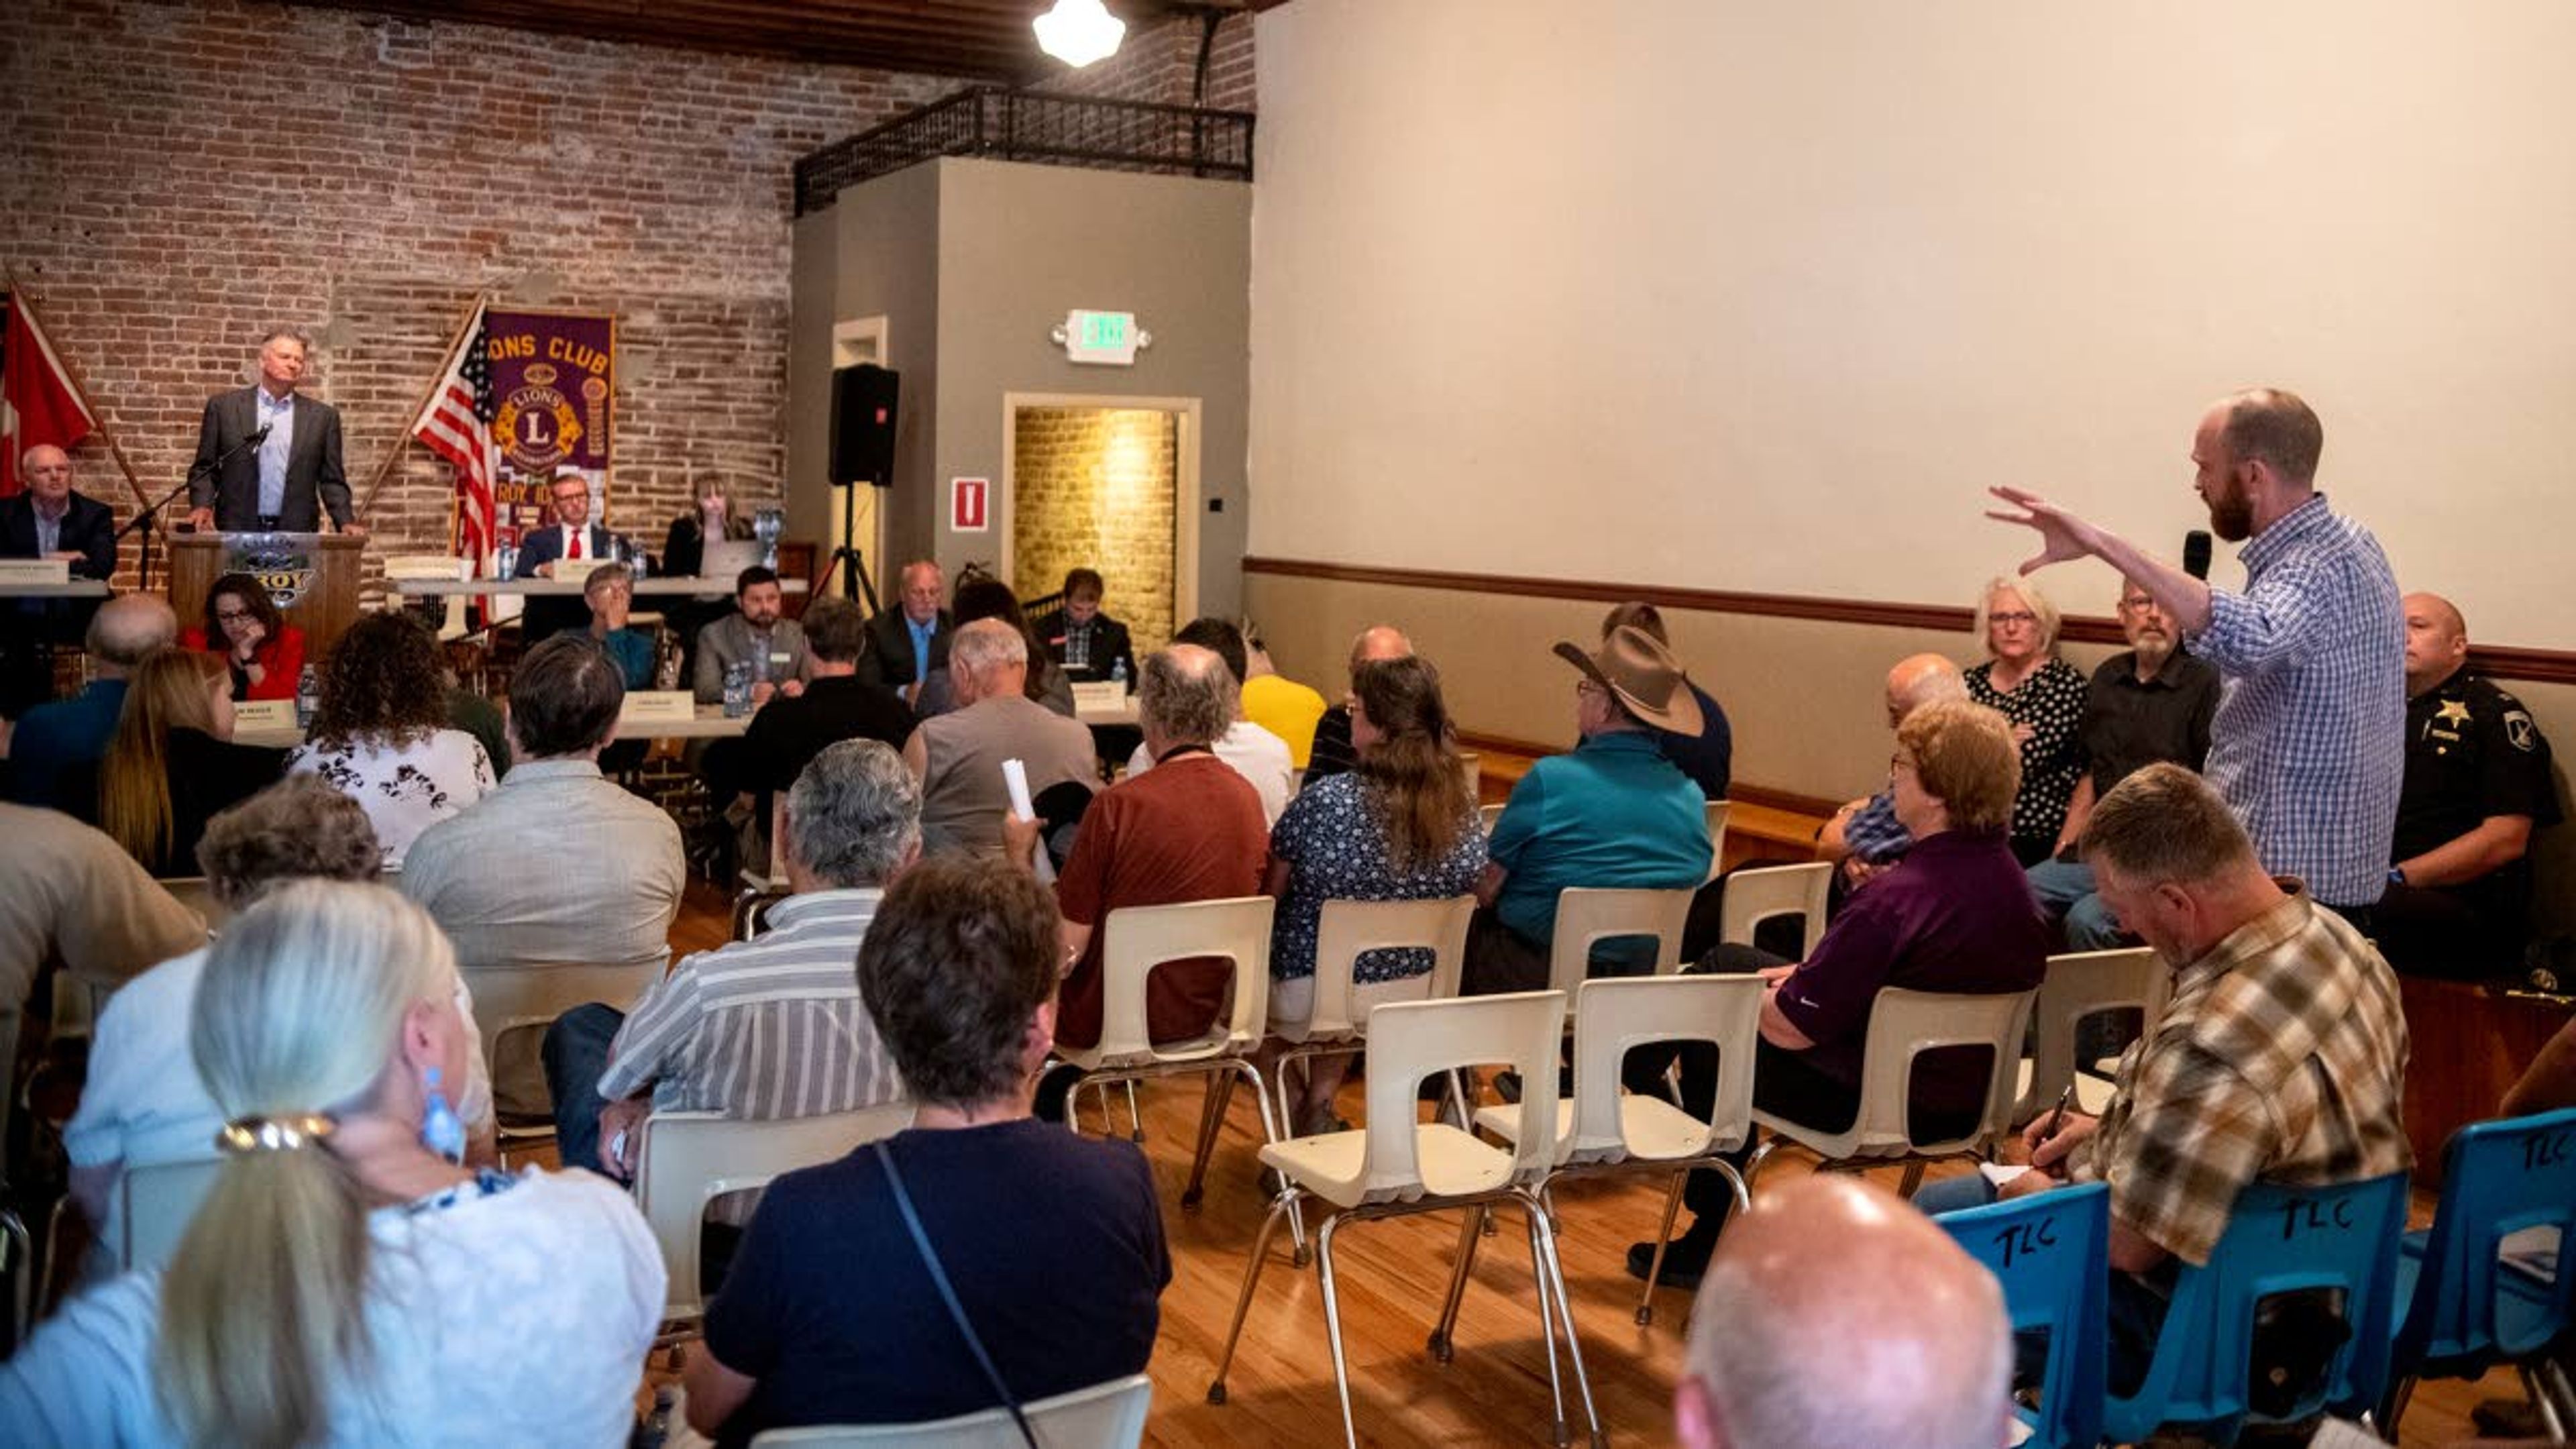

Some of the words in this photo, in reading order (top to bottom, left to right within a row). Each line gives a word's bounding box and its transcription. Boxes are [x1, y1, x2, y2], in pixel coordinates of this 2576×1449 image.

[489, 335, 535, 360] ONS
[549, 337, 608, 374] CLUB
[514, 389, 562, 407] LIONS
[525, 412, 549, 443] L
[498, 482, 527, 502] ROY
[535, 484, 553, 504] ID
[258, 572, 305, 589] ROY
[2520, 1132, 2569, 1171] TLC
[2277, 1198, 2353, 1241] TLC
[1992, 1216, 2055, 1269] TLC
